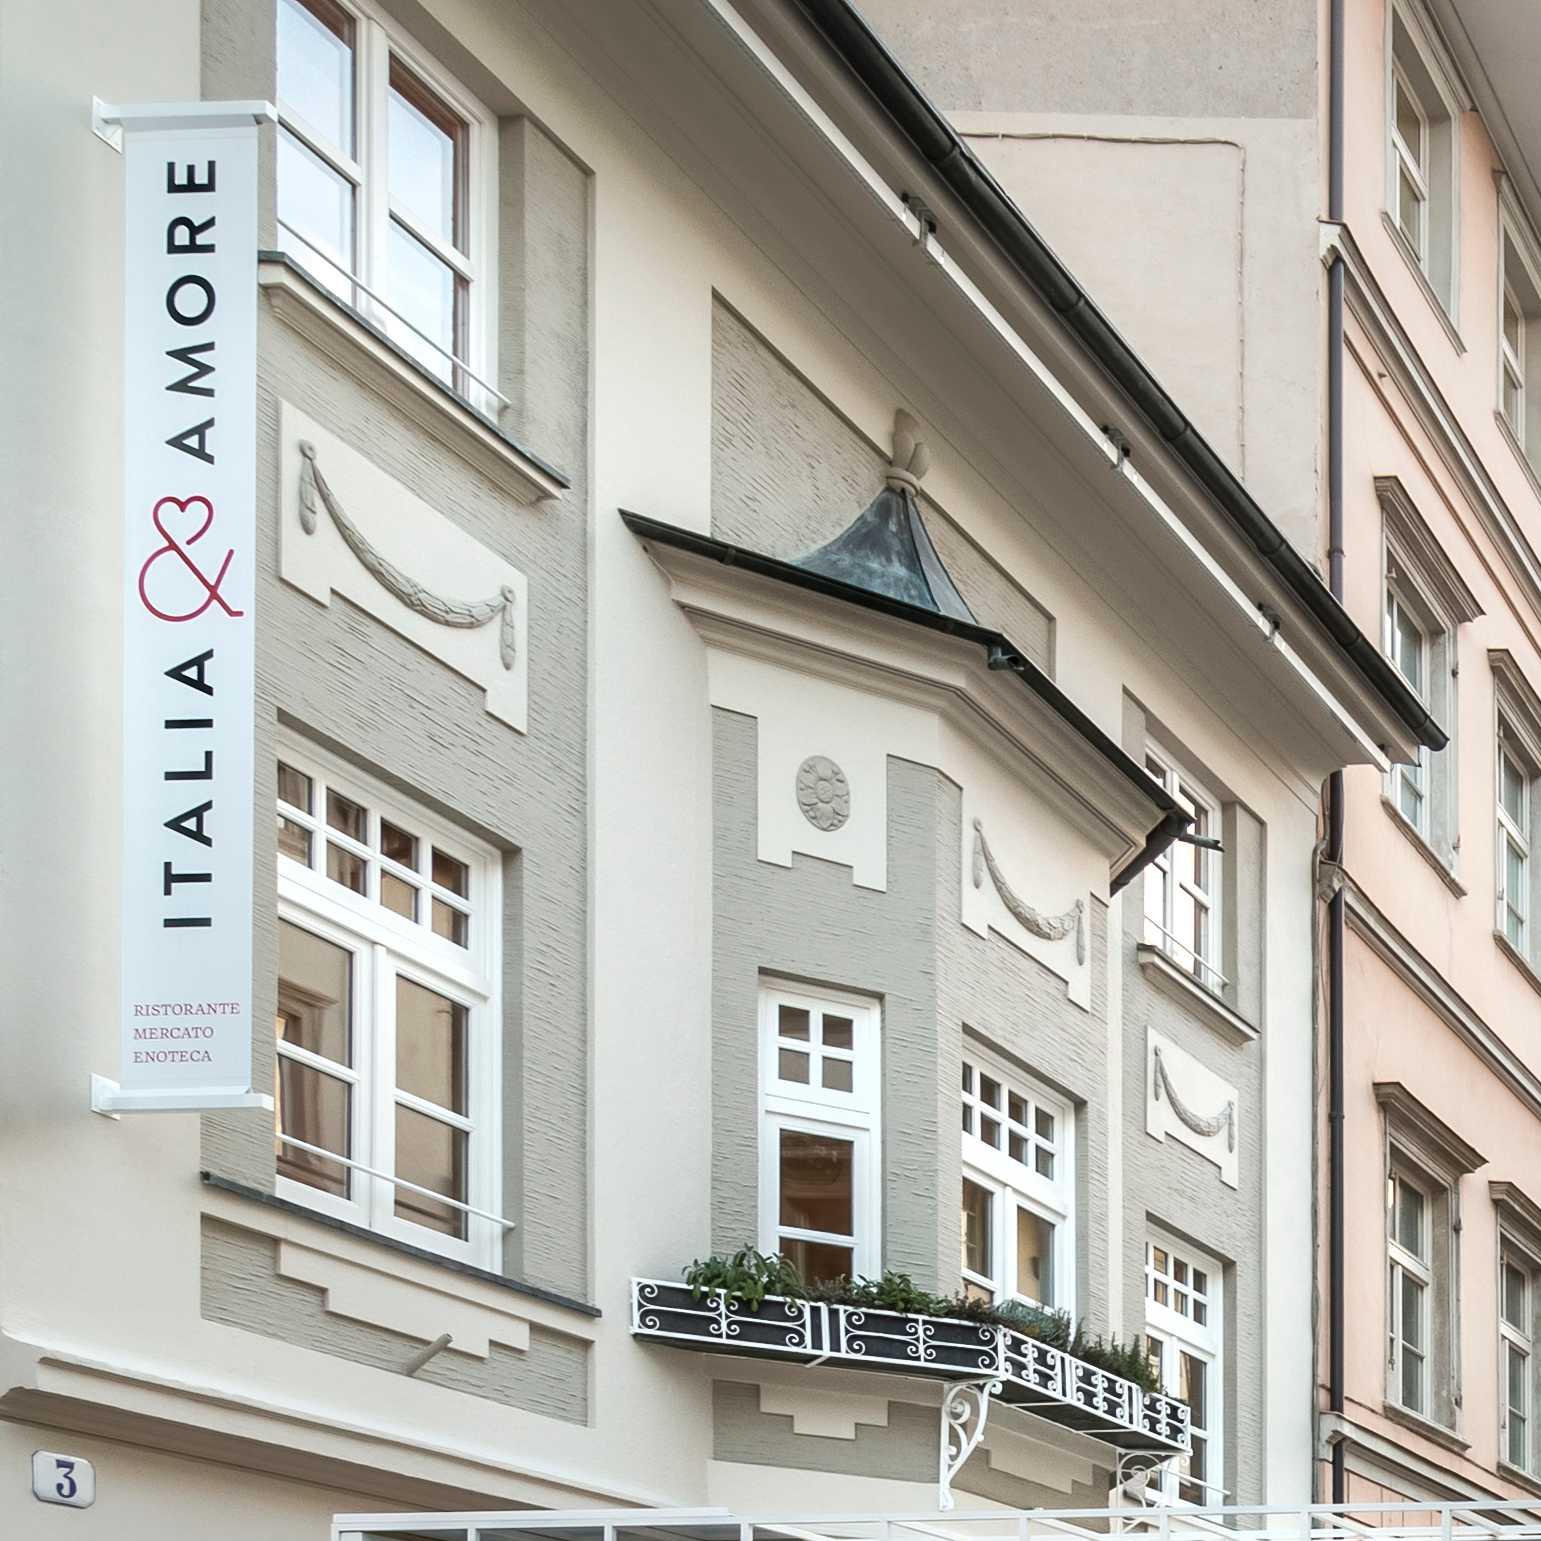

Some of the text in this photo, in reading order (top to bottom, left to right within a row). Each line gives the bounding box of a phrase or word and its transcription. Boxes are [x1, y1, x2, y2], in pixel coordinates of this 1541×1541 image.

[166, 158, 217, 465] AMORE
[163, 649, 213, 928] ITALIA
[134, 1003, 241, 1016] RISTORANTE
[134, 1027, 214, 1039] MERCATO
[133, 1050, 213, 1063] ENOTECA
[56, 1459, 77, 1498] 3
